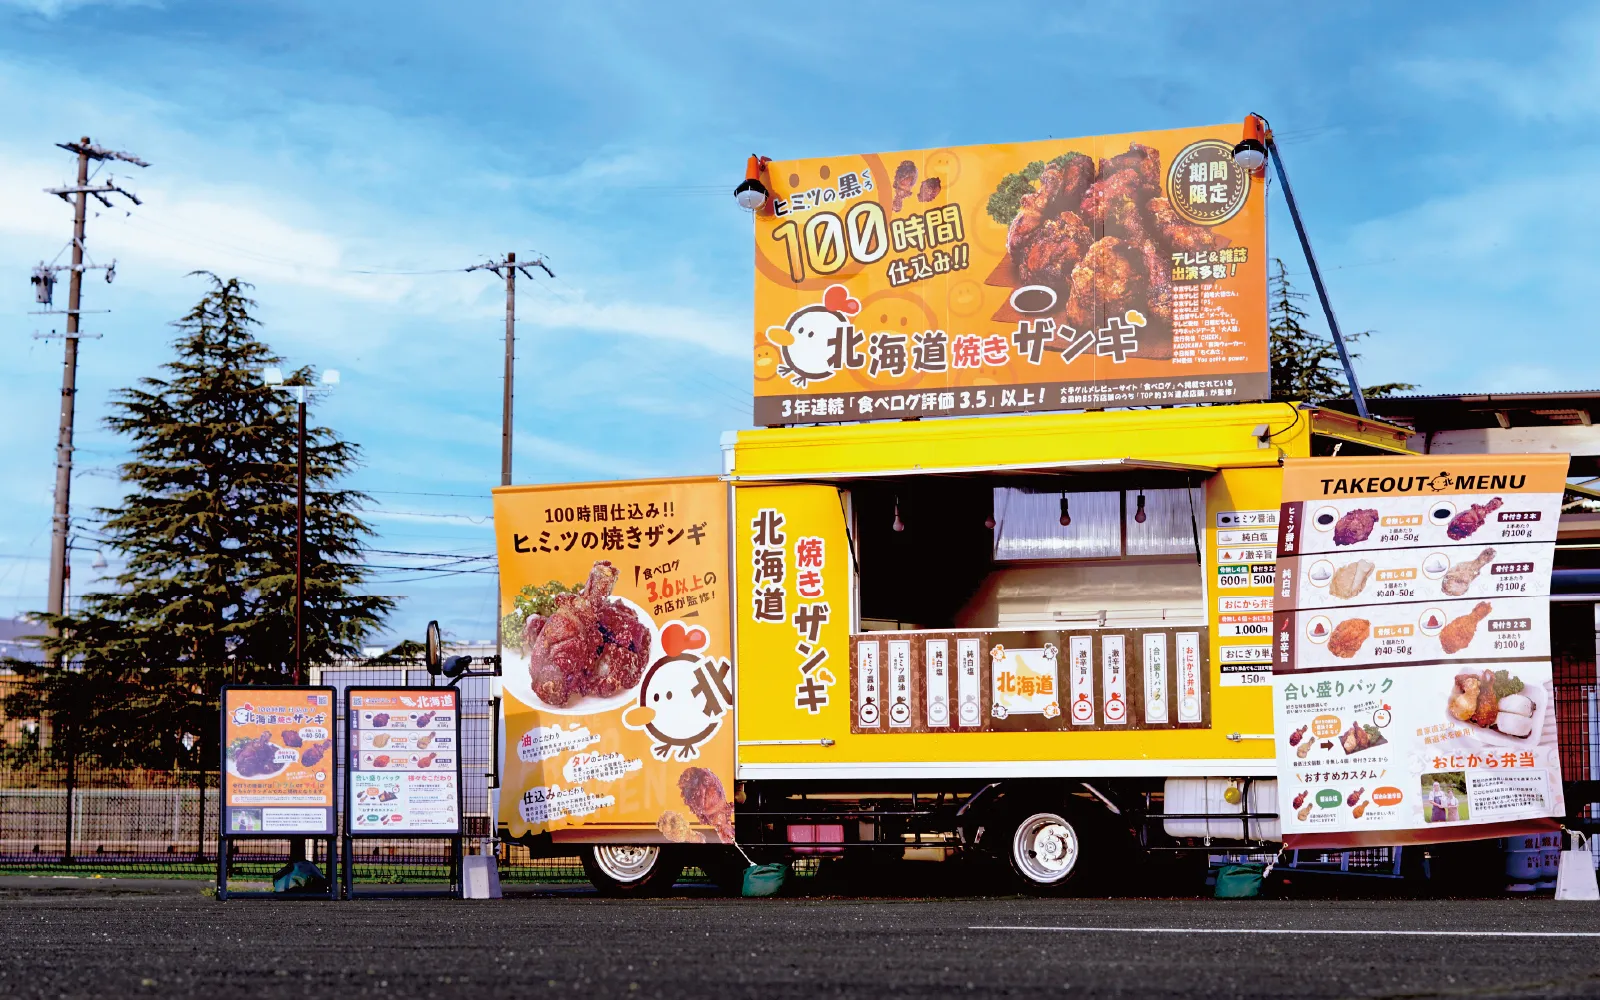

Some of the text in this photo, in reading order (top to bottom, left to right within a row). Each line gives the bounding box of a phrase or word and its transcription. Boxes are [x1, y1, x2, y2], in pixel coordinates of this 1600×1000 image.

[1189, 161, 1228, 182] 期間
[1189, 183, 1228, 205] 限定
[1321, 476, 1429, 495] TAKEOUT
[1455, 475, 1526, 490] MENU
[1233, 513, 1276, 523] ヒミツ醤油
[1241, 532, 1268, 541] 純白塩
[1284, 507, 1295, 551] ヒミツ醤油
[1245, 550, 1273, 559] 激辛旨
[642, 558, 681, 580] 食べログ
[752, 510, 785, 621] 北海道
[645, 571, 717, 603] 3.6以上の
[1220, 575, 1247, 585] 600円
[1253, 574, 1275, 584] 500
[1235, 624, 1268, 635] 1,000円
[1112, 649, 1120, 674] 激辛旨
[1226, 648, 1273, 658] おにぎり単
[936, 650, 944, 676] 純白塩
[966, 650, 974, 676] 純白塩
[1186, 646, 1194, 695] おにから弁当
[996, 671, 1054, 697] 北海道
[1241, 674, 1266, 684] 150円
[1284, 677, 1394, 701] 合い盛りパック
[416, 694, 453, 708] 北海道
[521, 732, 560, 748] 油のこだわり
[1432, 751, 1535, 769] おにから弁当
[1304, 769, 1378, 783] おすすめカスタム
[523, 787, 585, 806] 仕込みのこだわり
